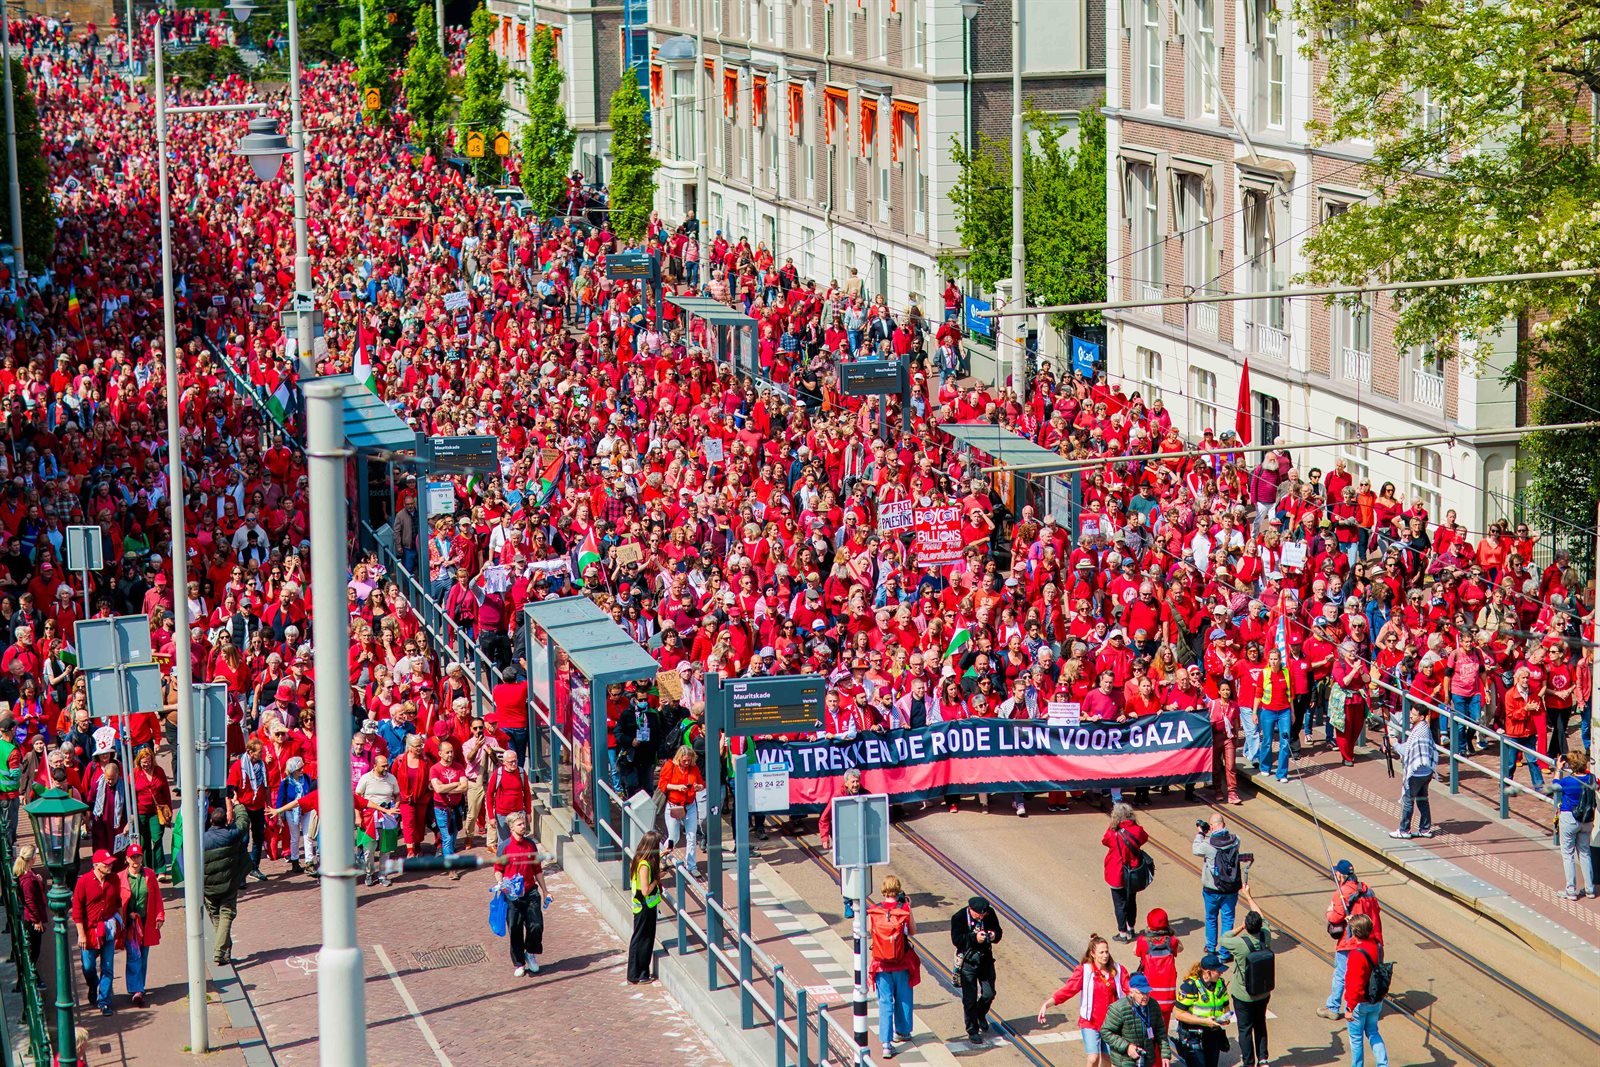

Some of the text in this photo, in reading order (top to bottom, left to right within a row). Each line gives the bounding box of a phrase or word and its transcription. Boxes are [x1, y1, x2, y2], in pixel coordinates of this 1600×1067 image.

[891, 501, 911, 513] FREE
[881, 513, 912, 529] PALESTINE
[915, 507, 961, 525] BOYCOTT
[661, 672, 675, 681] STOP
[733, 692, 770, 700] Mauritskade
[755, 720, 1194, 773] WIJ TREKKEN DE RODE LIJN VOOR GAZA
